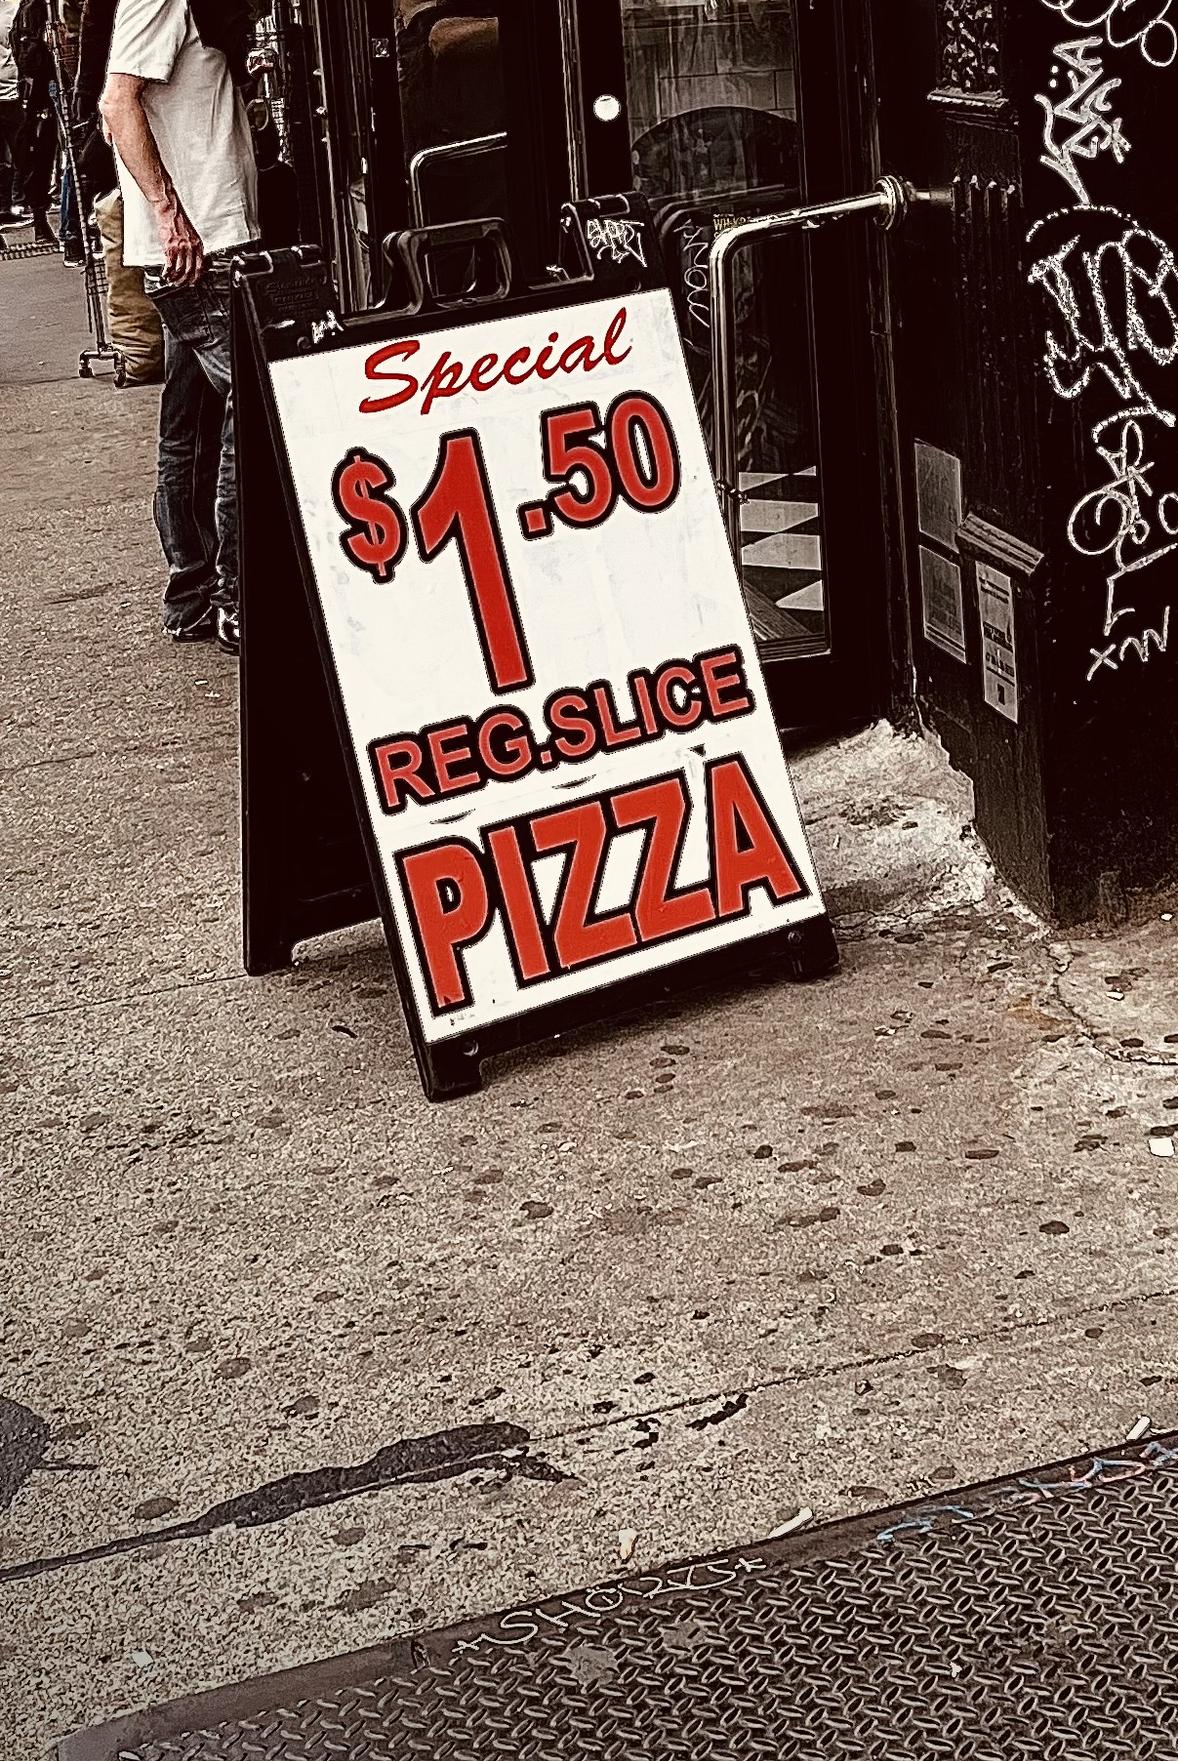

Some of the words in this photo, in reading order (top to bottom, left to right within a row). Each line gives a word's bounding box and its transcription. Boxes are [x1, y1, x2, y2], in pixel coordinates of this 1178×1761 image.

[359, 308, 633, 415] Special
[331, 390, 682, 695] $1.50
[366, 645, 757, 816] REG.SLICE
[395, 751, 810, 1016] PIZZA
